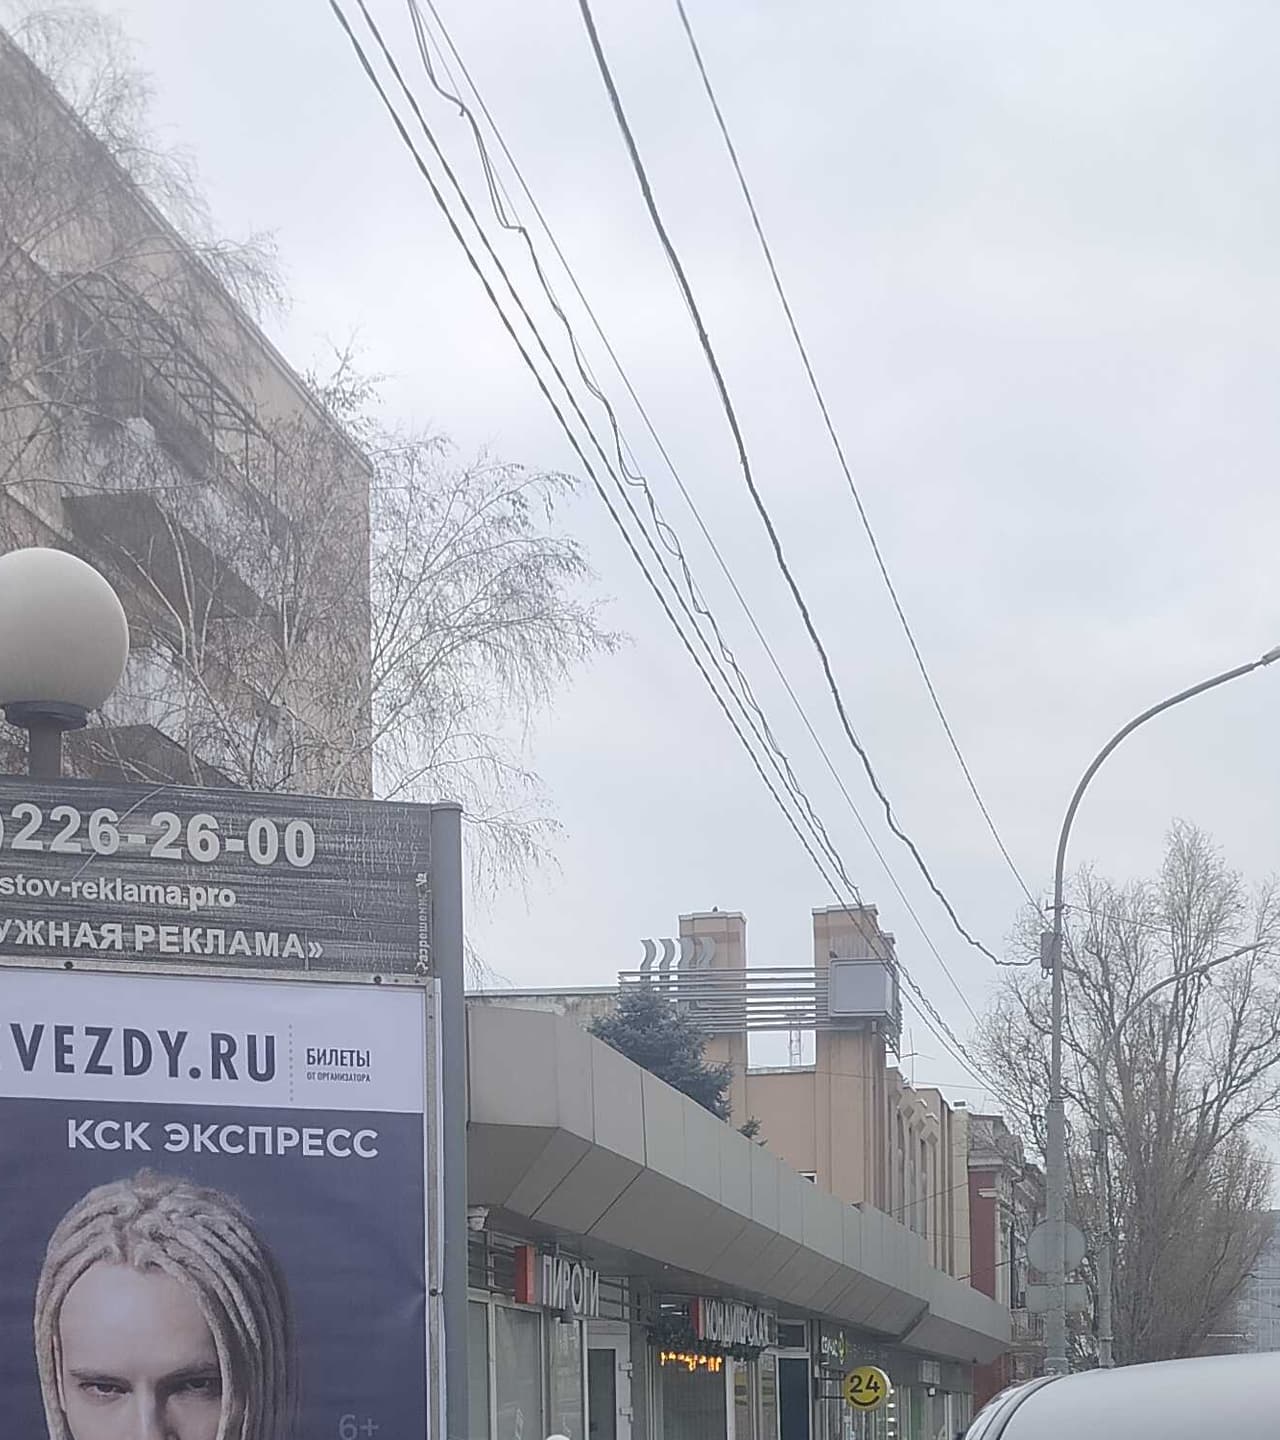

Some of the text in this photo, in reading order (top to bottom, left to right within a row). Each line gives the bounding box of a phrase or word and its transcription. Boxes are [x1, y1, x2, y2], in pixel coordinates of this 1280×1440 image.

[134, 923, 324, 960] РЕКЛАМА»
[306, 1047, 370, 1067] БИЛЕТЫ
[306, 1071, 371, 1082] ОТ ОРГАНИЗАТОРА
[67, 1118, 379, 1159] КСК ЭКСПРЕСС
[542, 1253, 600, 1317] ПИРОГИ
[849, 1374, 880, 1393] 24
[339, 1413, 379, 1440] 6+
